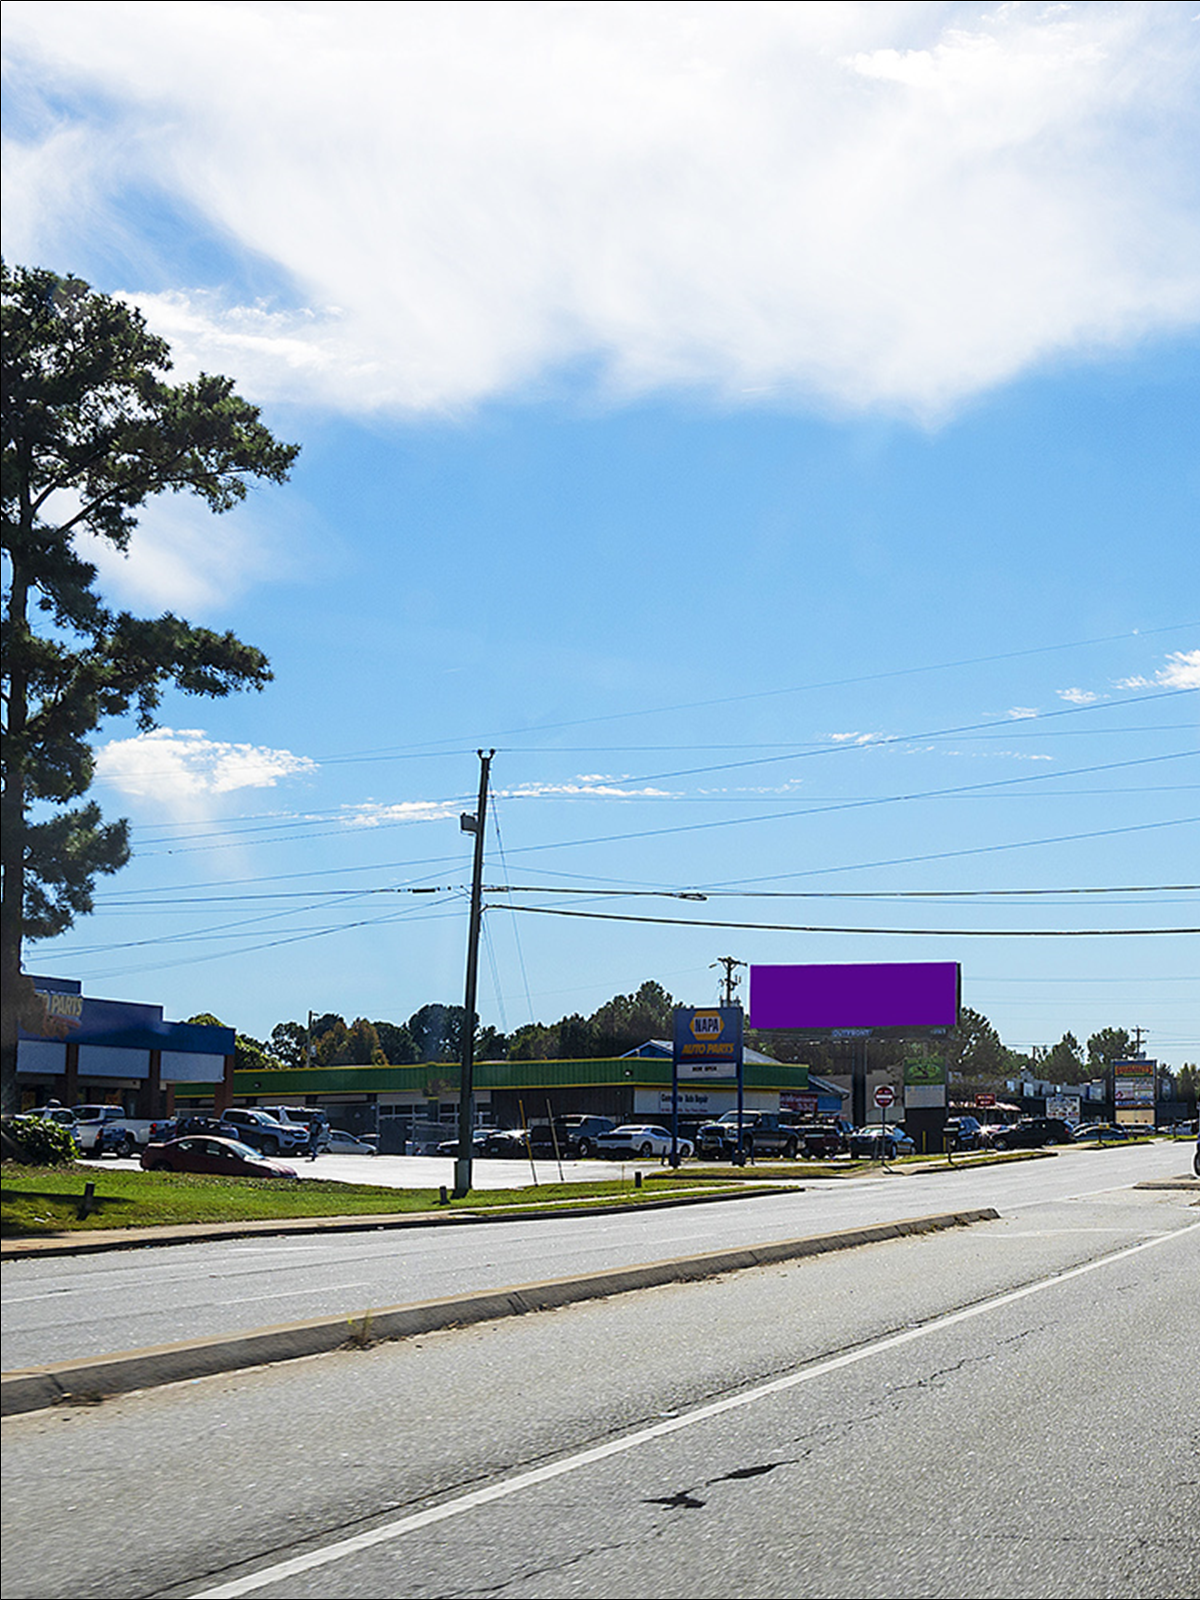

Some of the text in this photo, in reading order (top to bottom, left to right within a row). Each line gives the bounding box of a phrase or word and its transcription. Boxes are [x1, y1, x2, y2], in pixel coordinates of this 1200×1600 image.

[51, 994, 83, 1016] PARTS
[695, 1018, 719, 1032] NAPA
[681, 1043, 734, 1054] AUTO PARTS
